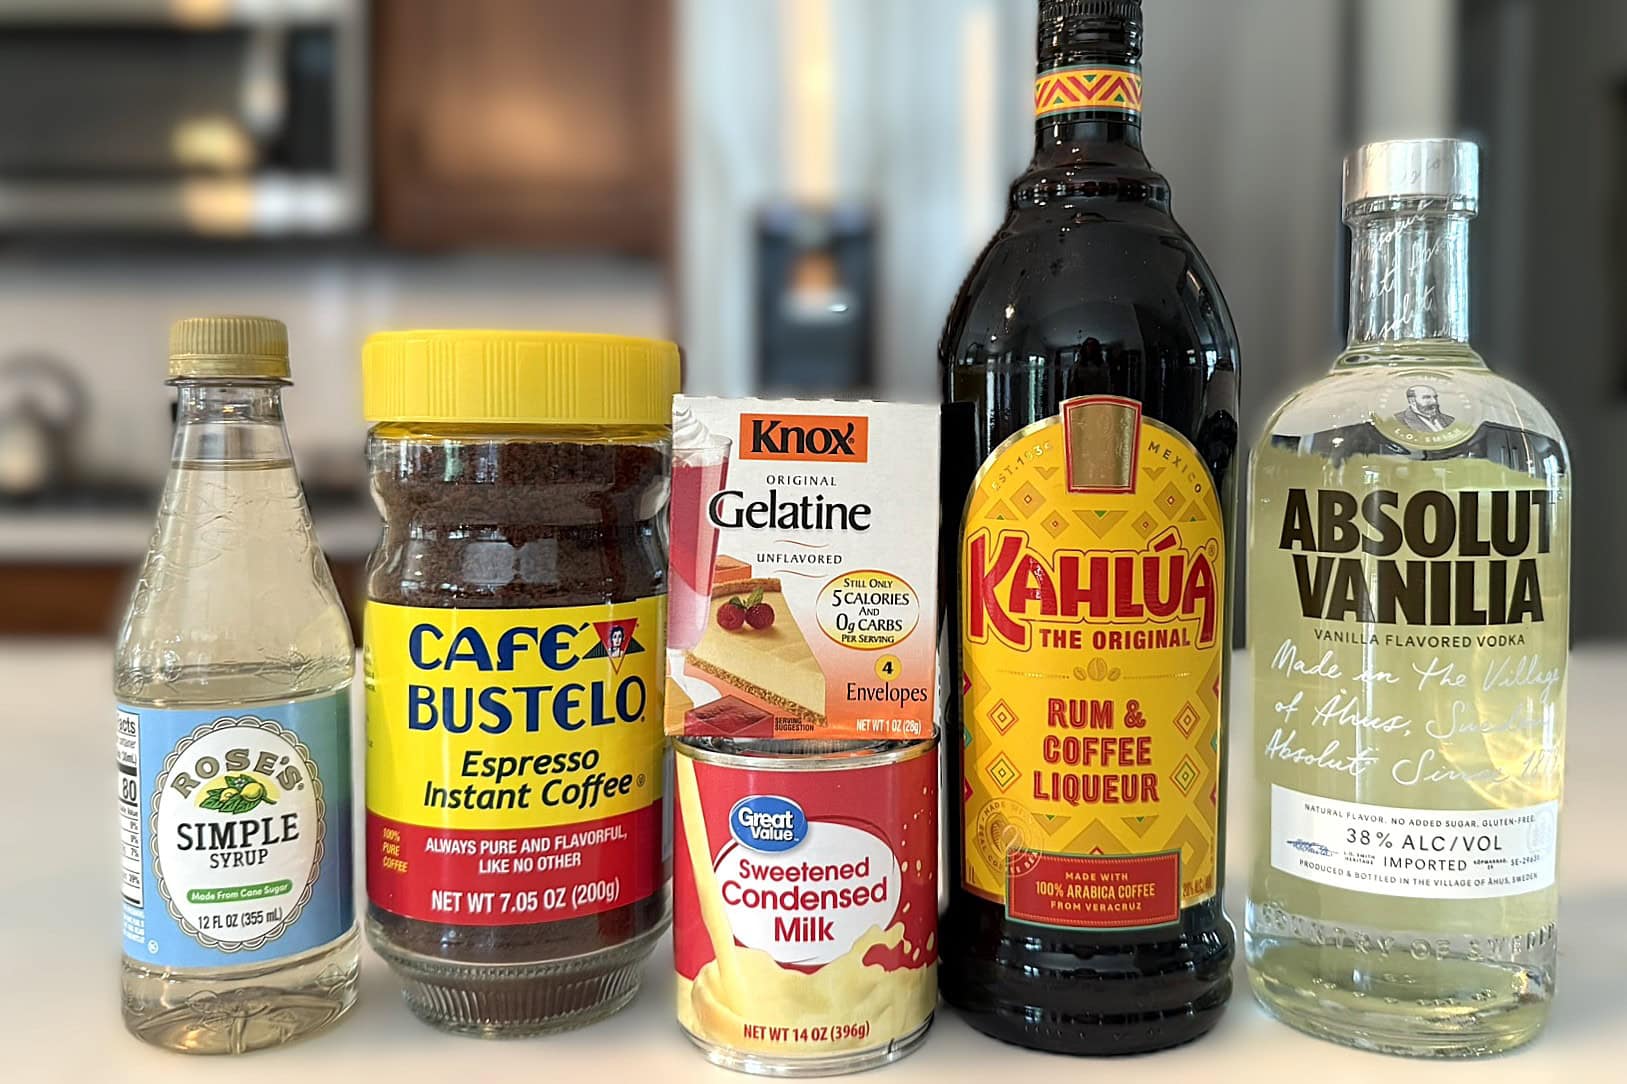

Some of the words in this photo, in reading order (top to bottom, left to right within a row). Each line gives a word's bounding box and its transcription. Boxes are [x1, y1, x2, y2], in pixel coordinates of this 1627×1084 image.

[751, 419, 855, 456] Knox
[1148, 441, 1202, 493] MEXICO
[766, 474, 838, 487] ORIGINAL
[708, 490, 871, 531] Gelatine
[1279, 488, 1552, 558] ABSOLUT
[756, 553, 843, 565] UNFLAVORED
[843, 578, 866, 588] STILL
[869, 578, 893, 589] ONLY
[970, 533, 1215, 646] KAHLÚA
[1293, 554, 1544, 626] VANILIA
[832, 590, 842, 607] 5
[844, 593, 910, 606] CALORIES
[836, 613, 855, 633] 0g
[858, 619, 903, 631] CARBS
[859, 606, 880, 616] AND
[408, 621, 591, 672] CAFÉ
[841, 634, 857, 643] PER
[858, 634, 894, 643] SERVING
[1040, 628, 1082, 649] THE
[1092, 627, 1190, 650] ORIGINAL
[1314, 628, 1380, 646] VANILLA
[1385, 635, 1472, 648] FLAVORED
[1476, 634, 1526, 648] VODKA
[882, 661, 894, 674] 4
[1271, 639, 1342, 679] Made
[1412, 657, 1466, 691] the
[408, 675, 646, 734] BUSTELO
[847, 682, 927, 708] Envelopes
[1275, 690, 1303, 723] of
[1047, 697, 1114, 729] RUM
[1123, 699, 1147, 729] &
[775, 724, 815, 732] SUGGESTION
[856, 720, 871, 731] NET
[872, 720, 885, 731] WT
[886, 720, 890, 731] 1
[891, 720, 902, 731] OZ
[902, 720, 921, 734] (28g)
[1043, 734, 1152, 767] COFFEE
[1265, 728, 1379, 776] Absolut
[170, 748, 299, 799] ROSE'S
[461, 749, 599, 783] Espresso
[122, 777, 137, 801] 80
[423, 780, 531, 809] Instant
[541, 771, 633, 810] Coffee
[1033, 770, 1160, 808] LIQUEUR
[738, 807, 794, 829] Great
[1304, 803, 1343, 818] NATURAL
[1409, 819, 1442, 827] ADDED
[177, 813, 300, 852] SIMPLE
[383, 827, 400, 842] 100%
[426, 836, 477, 854] ALWAYS
[480, 838, 517, 855] PURE
[521, 836, 551, 853] AND
[554, 825, 627, 851] FLAVORFUL,
[751, 825, 794, 842] Value
[1346, 827, 1393, 849] 38%
[1402, 834, 1503, 852] ALC/VOL
[210, 849, 269, 868] SYRUP
[383, 841, 400, 856] PURE
[383, 856, 408, 873] COFFEE
[479, 857, 509, 874] LIKE
[513, 856, 534, 873] NO
[538, 852, 581, 871] OTHER
[739, 856, 870, 882] Sweetened
[1299, 858, 1344, 876] PRODUCED
[1355, 872, 1396, 884] BOTTLED
[1413, 878, 1430, 886] THE
[1434, 879, 1471, 887] VILLAGE
[1474, 879, 1485, 887] OF
[1383, 856, 1467, 871] IMPORTED
[1065, 871, 1097, 881] MADE
[1100, 871, 1128, 881] WITH
[191, 891, 215, 901] Made
[217, 891, 239, 900] From
[240, 889, 262, 897] Cane
[263, 884, 289, 895] Sugar
[431, 890, 461, 912] NET
[467, 892, 494, 913] WT
[500, 891, 538, 913] 7.05
[543, 886, 567, 908] OZ
[572, 876, 620, 909] (200g)
[721, 877, 888, 911] Condensed
[1036, 881, 1064, 898] 100%
[1067, 883, 1115, 899] ARABICA
[1118, 882, 1155, 898] COFFEE
[198, 915, 210, 929] 12
[213, 915, 223, 929] FL
[226, 913, 238, 928] OZ
[241, 910, 264, 928] (355
[266, 907, 283, 922] mL)
[1050, 901, 1081, 911] FROM
[1085, 901, 1142, 912] VERACRUZ
[774, 917, 835, 943] Milk
[743, 1023, 766, 1040] NET
[769, 1025, 790, 1041] WT
[793, 1025, 808, 1041] 14
[810, 1023, 828, 1040] OZ
[830, 1020, 870, 1042] (396g)
